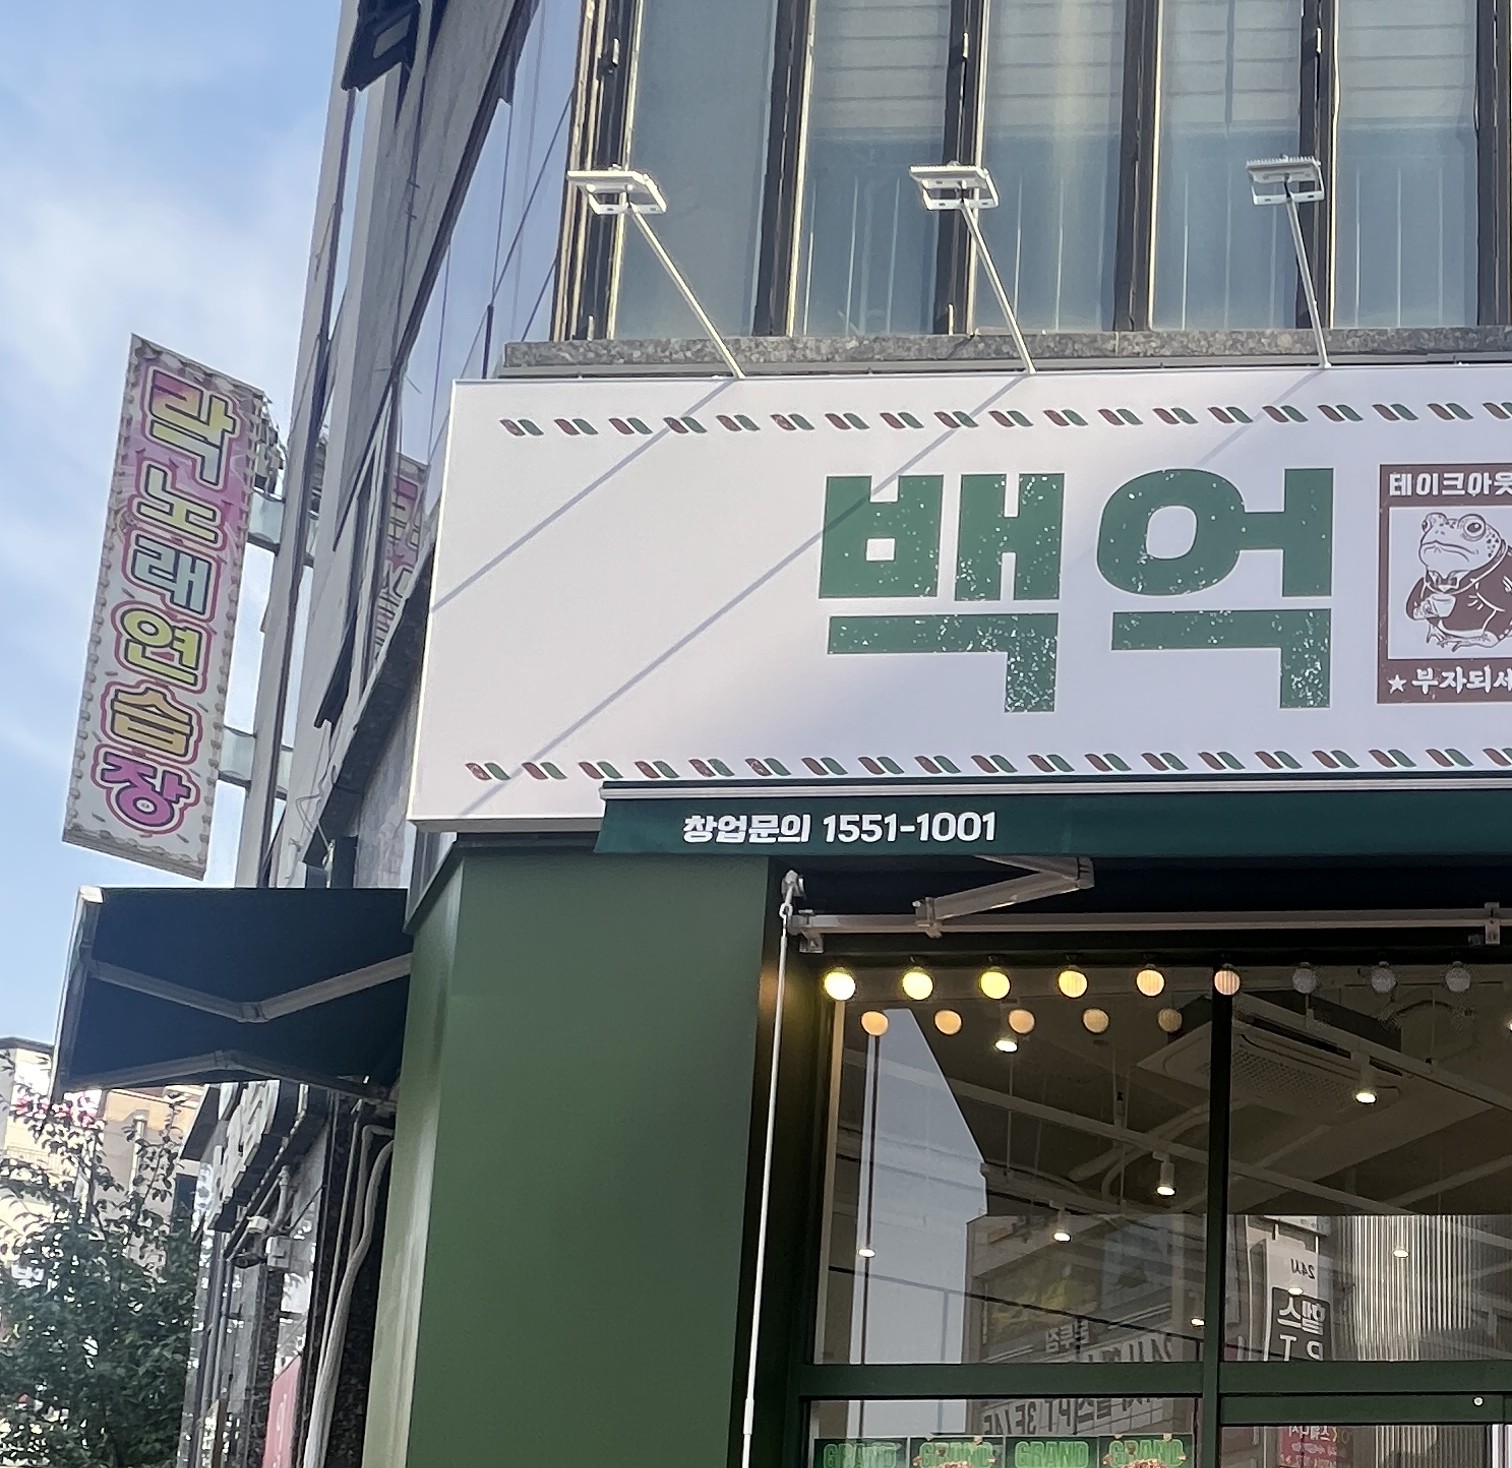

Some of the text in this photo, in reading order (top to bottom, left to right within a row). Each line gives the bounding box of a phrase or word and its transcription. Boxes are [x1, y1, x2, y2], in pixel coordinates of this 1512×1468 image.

[101, 369, 236, 828] 락노래연습장
[818, 468, 1334, 713] 백억
[682, 811, 996, 843] 창업문의 1551-1001
[1015, 1441, 1089, 1468] GRAND
